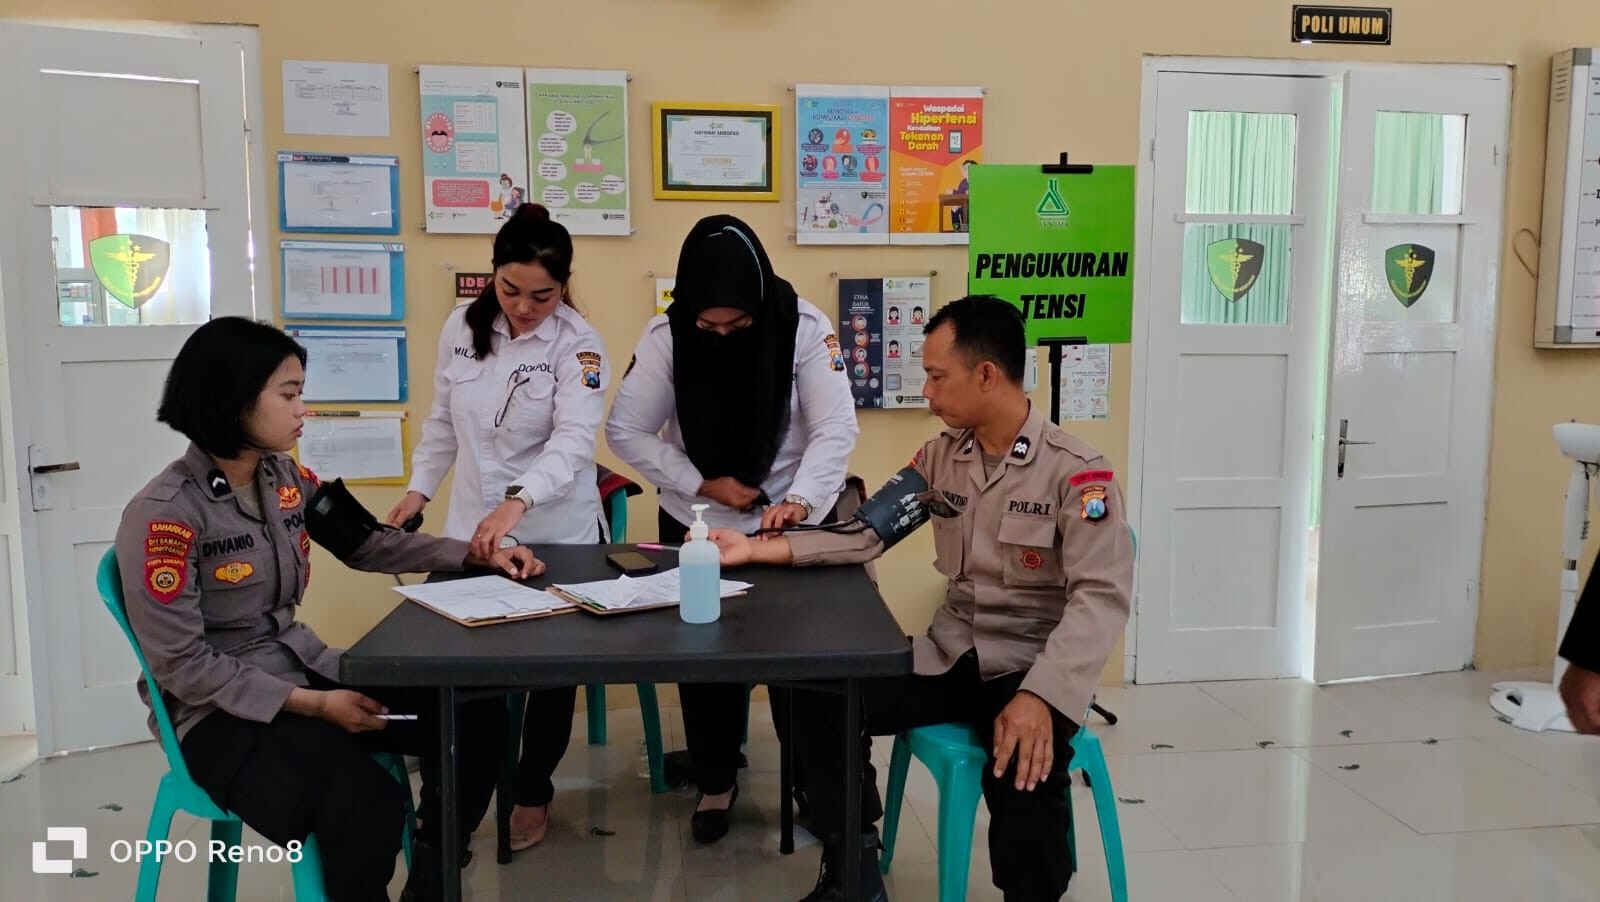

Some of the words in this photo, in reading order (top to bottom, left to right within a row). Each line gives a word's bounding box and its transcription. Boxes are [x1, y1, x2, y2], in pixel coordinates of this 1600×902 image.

[1301, 15, 1334, 33] POLI
[1338, 16, 1383, 35] UMUM
[911, 112, 977, 125] Hipertensi
[900, 131, 944, 142] Tekanan
[908, 141, 939, 151] Darah
[975, 252, 1129, 279] PENGUKURAN
[460, 276, 492, 288] IDE
[1019, 293, 1087, 320] TENSI
[1008, 500, 1051, 516] POLRI
[283, 511, 305, 533] POL
